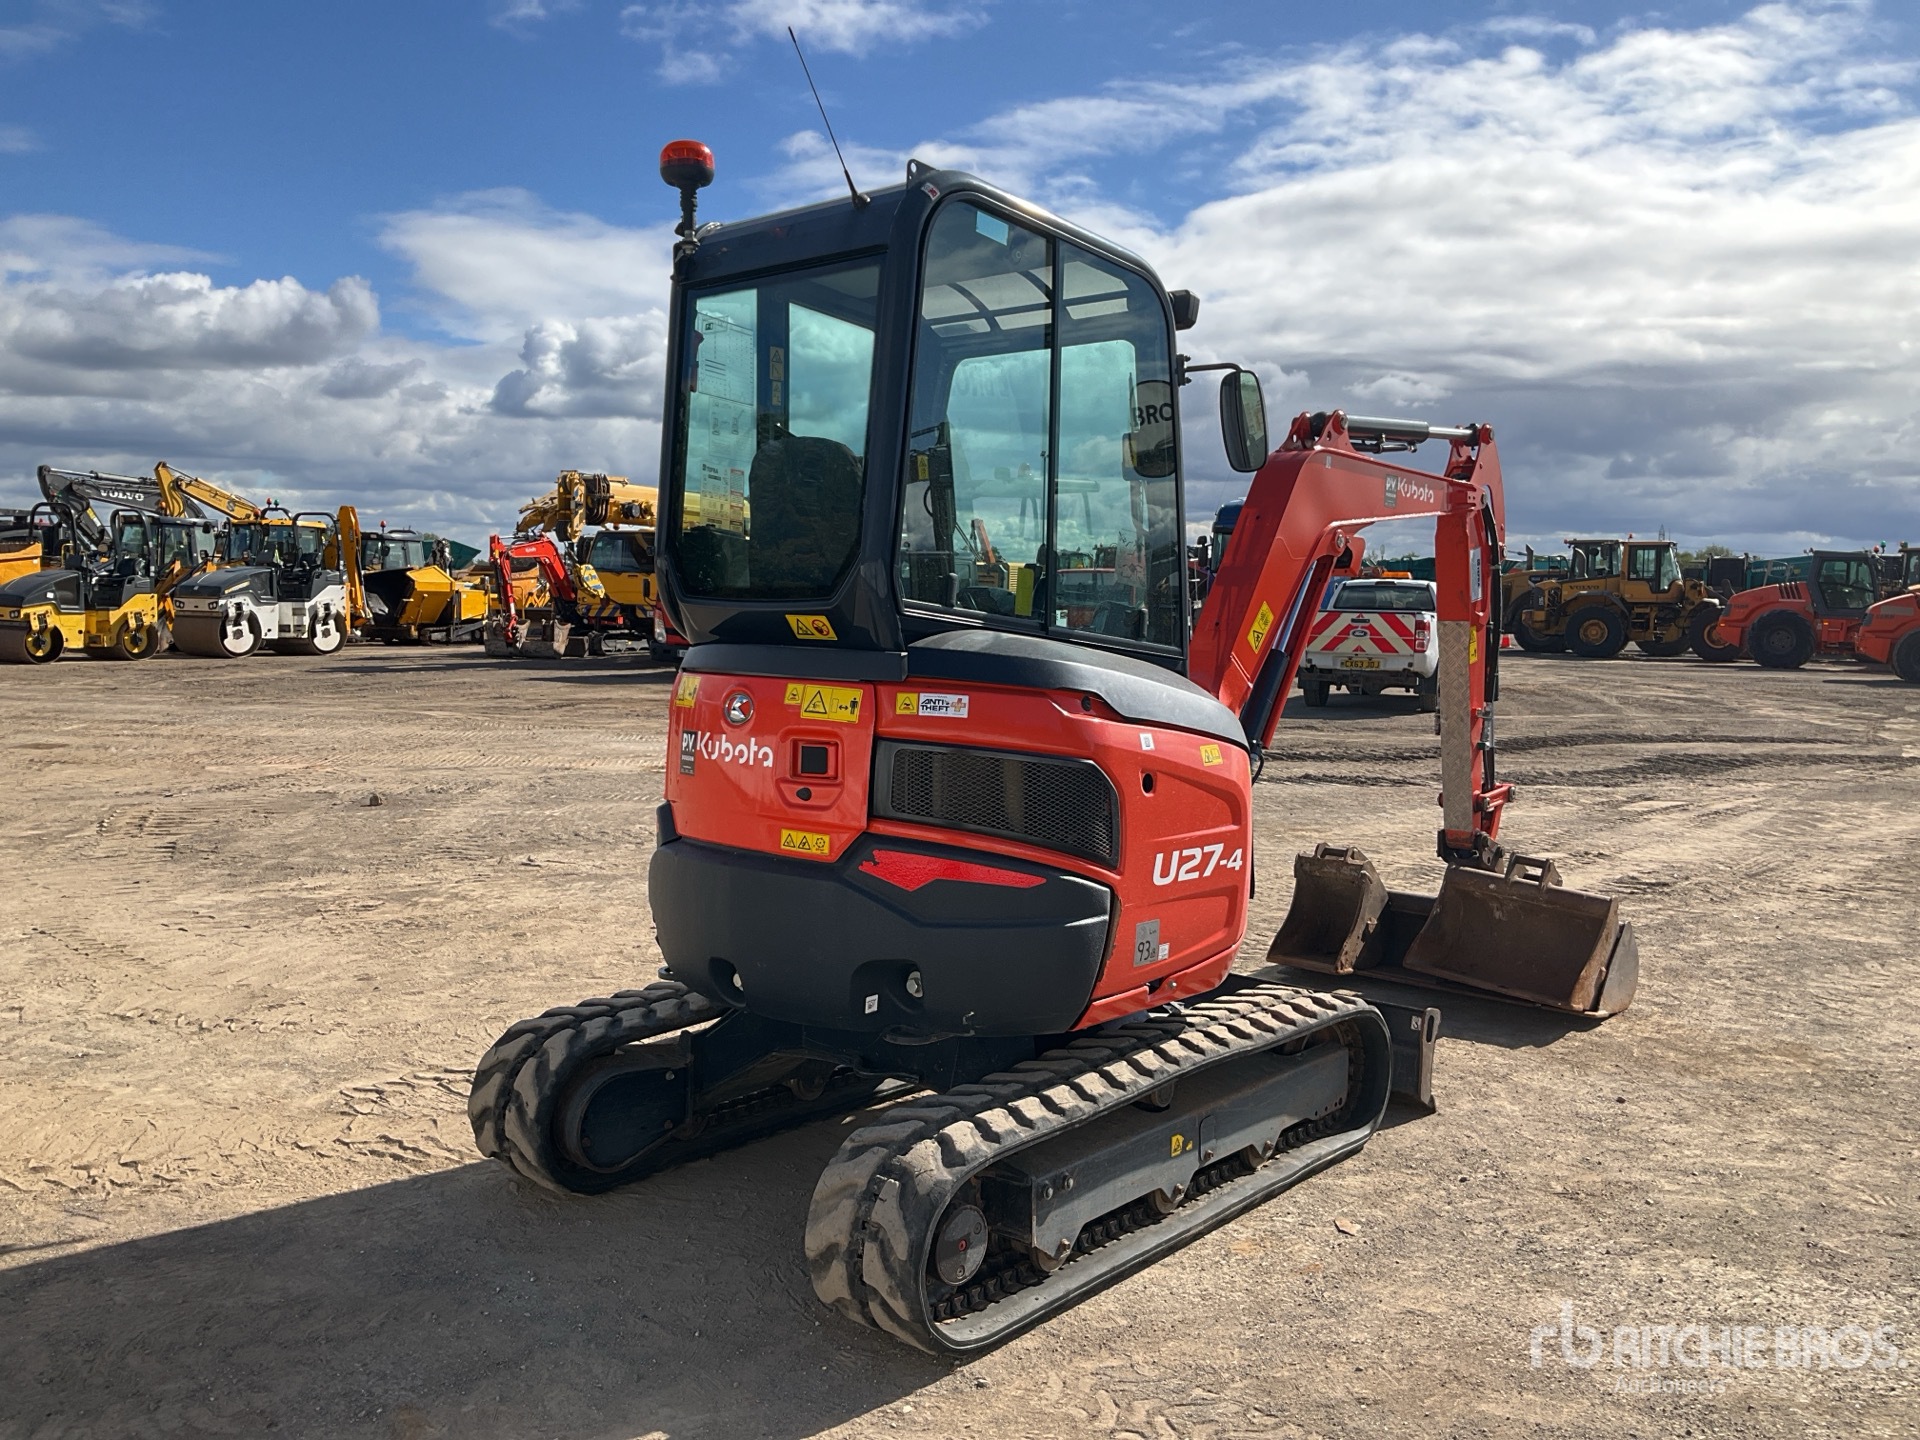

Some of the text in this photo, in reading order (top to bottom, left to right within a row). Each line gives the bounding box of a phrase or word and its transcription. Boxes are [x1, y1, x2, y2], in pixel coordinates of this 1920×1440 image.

[100, 489, 145, 501] VOLVO
[1397, 476, 1434, 504] Kubota
[920, 704, 950, 712] THEFT
[696, 730, 773, 768] Kubota
[1152, 843, 1243, 886] U27-4
[1137, 940, 1151, 962] 93
